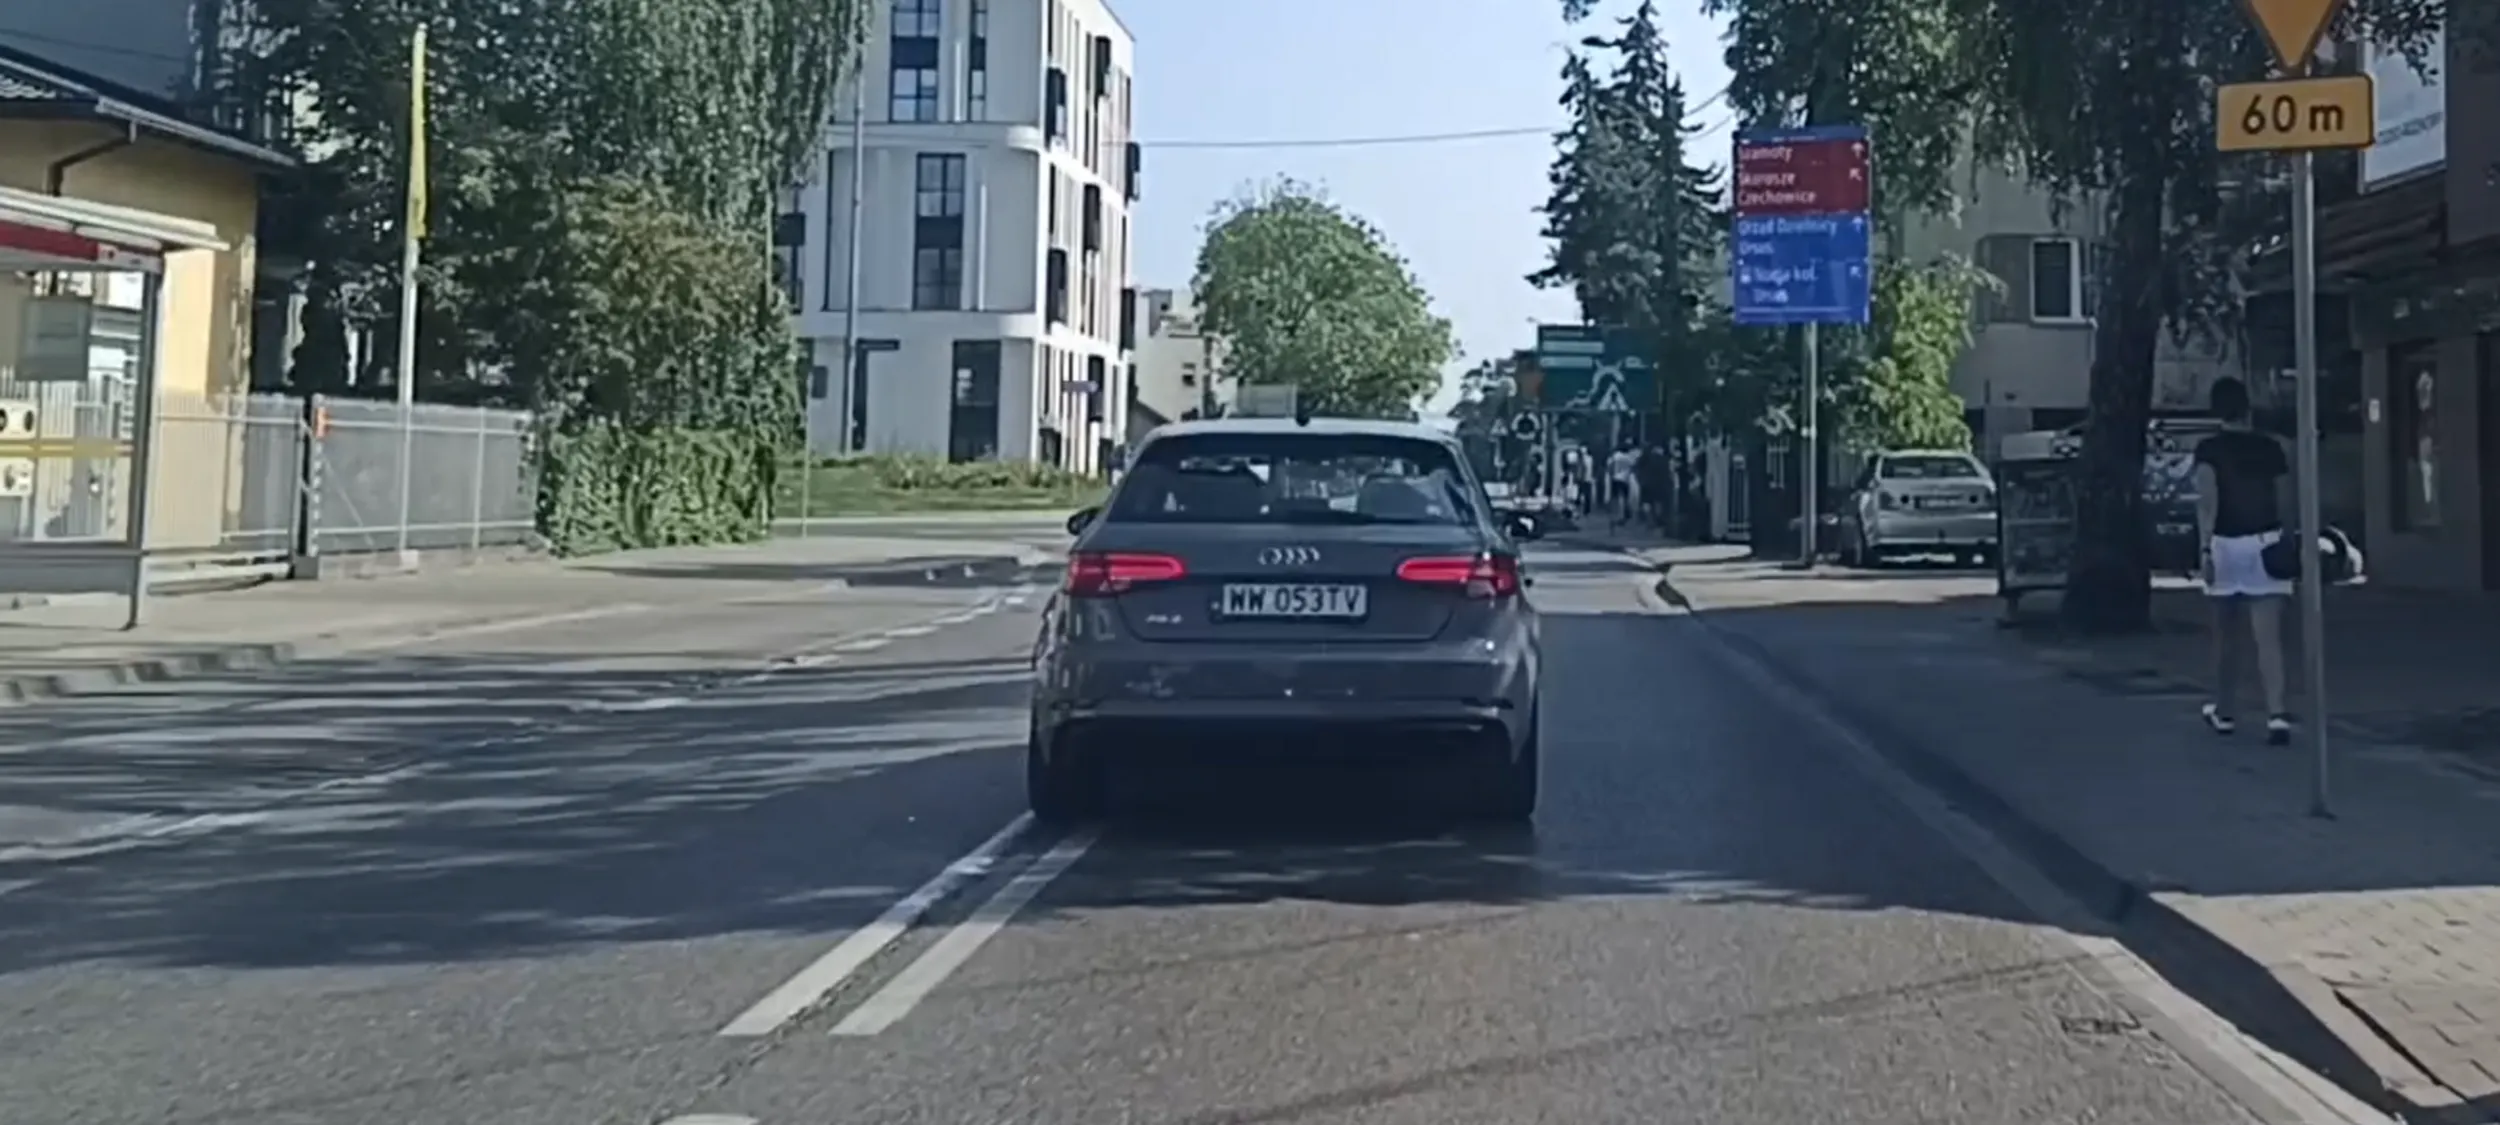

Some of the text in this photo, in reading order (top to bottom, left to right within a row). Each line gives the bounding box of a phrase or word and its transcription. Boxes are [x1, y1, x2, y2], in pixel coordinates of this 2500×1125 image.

[2242, 93, 2297, 135] 60
[2308, 104, 2344, 132] m
[1229, 586, 1360, 613] WW 053TV
